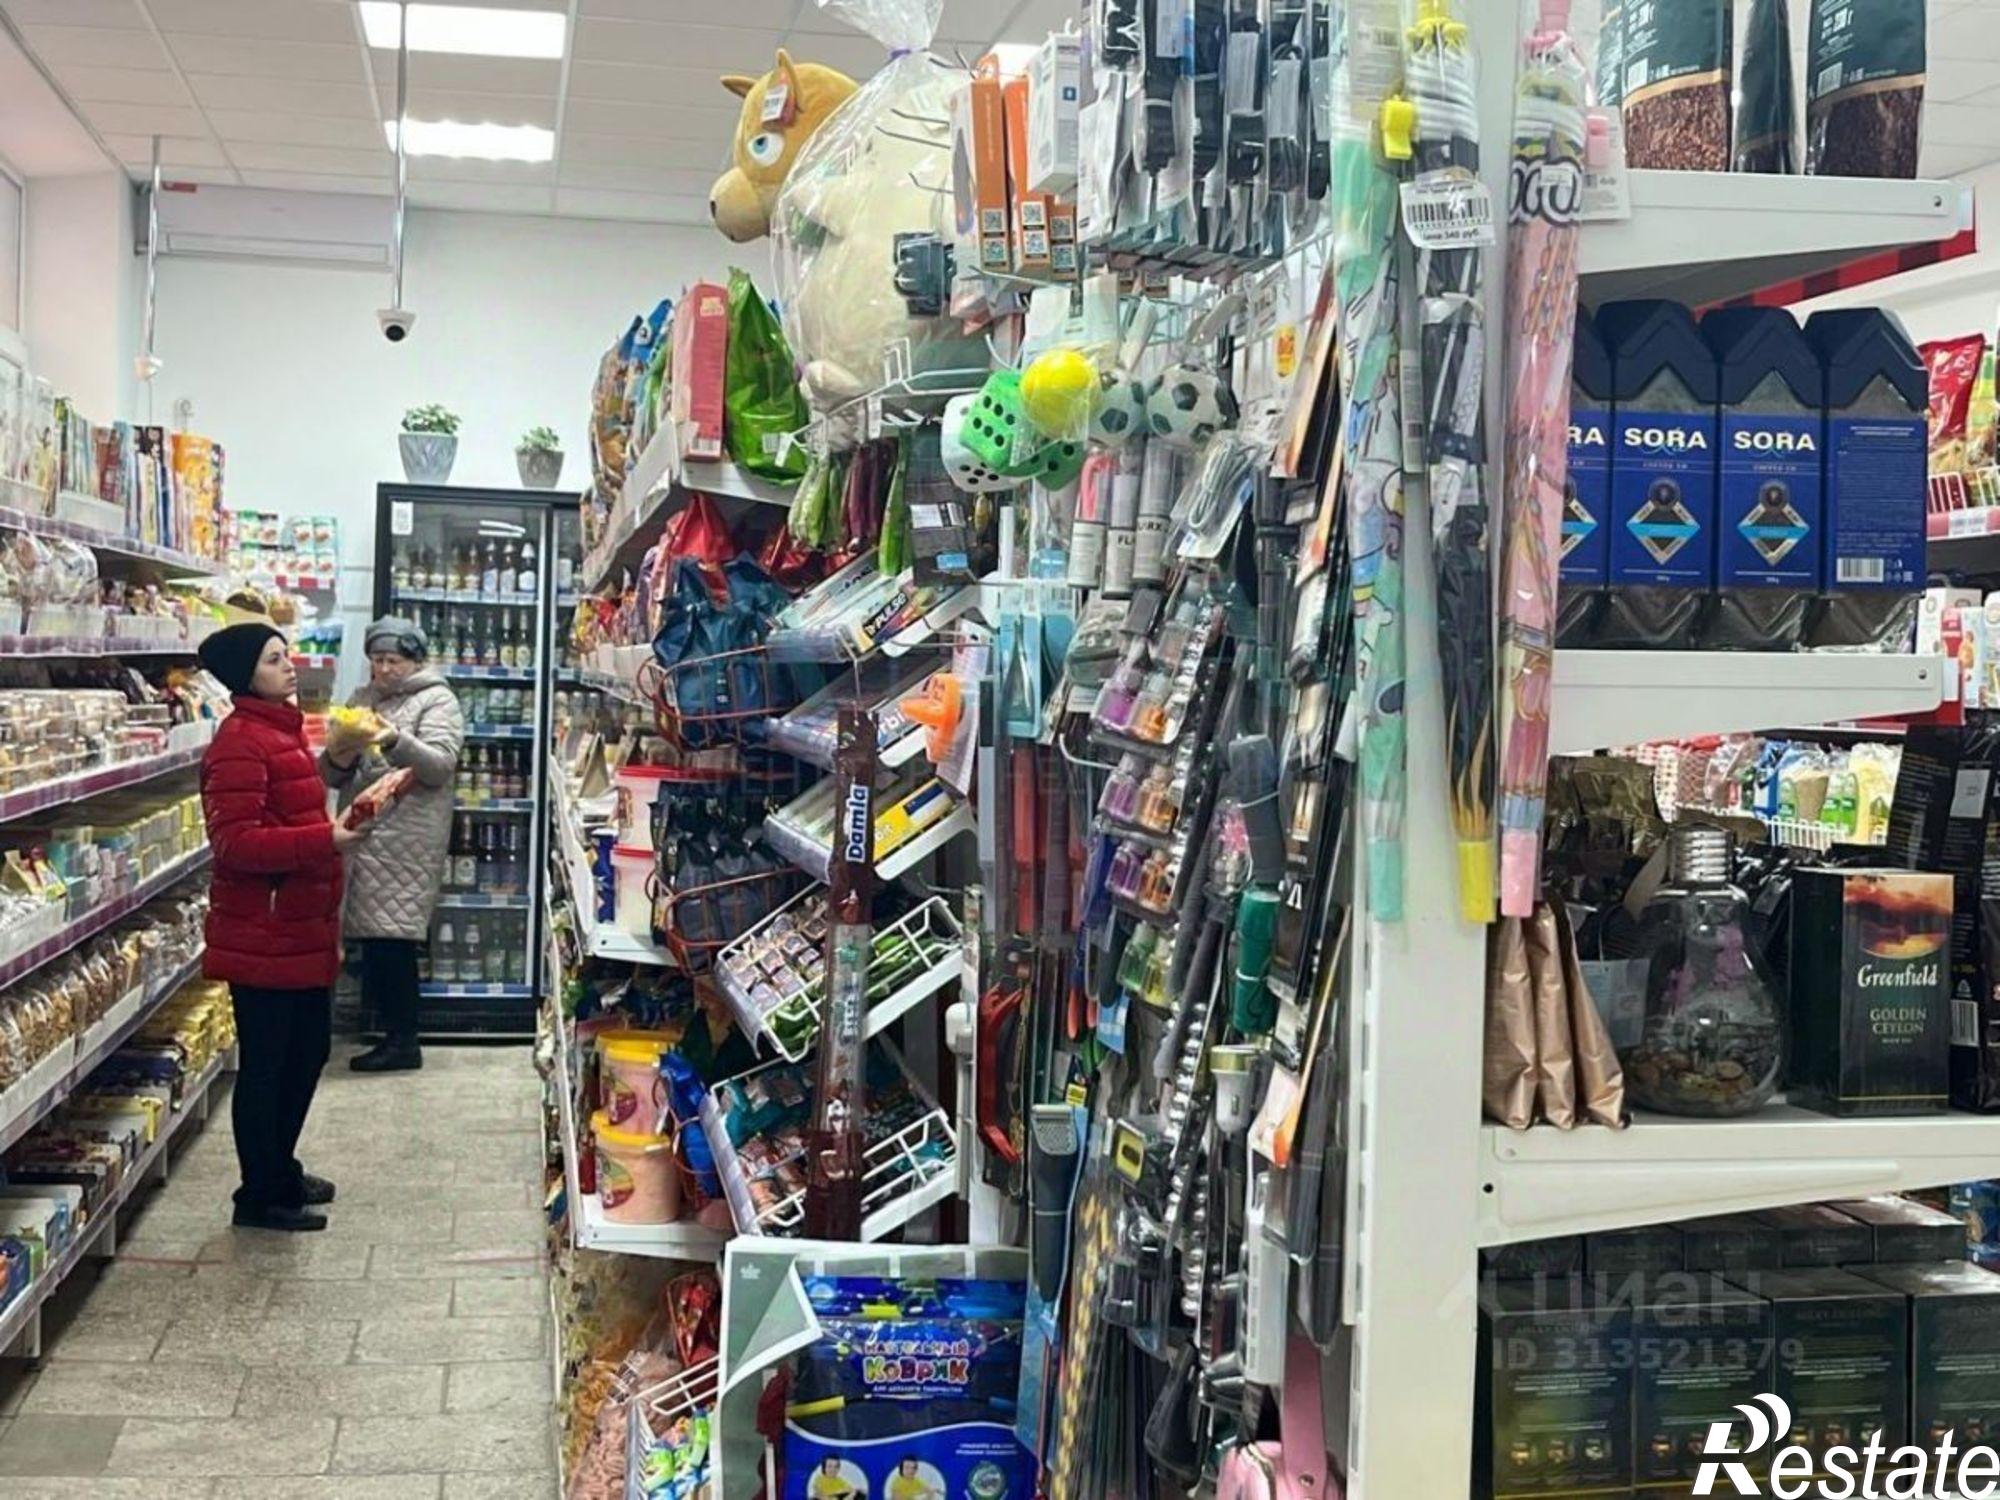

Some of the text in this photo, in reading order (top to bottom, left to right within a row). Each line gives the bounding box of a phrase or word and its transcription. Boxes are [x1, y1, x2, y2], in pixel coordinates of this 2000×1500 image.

[1567, 426, 1605, 446] RA
[1624, 427, 1707, 449] SORA
[1733, 430, 1816, 451] SORA
[847, 786, 867, 862] Damla
[1857, 963, 1938, 988] Greenfield
[1870, 1008, 1927, 1022] GOLDEN
[1872, 1022, 1924, 1035] CEYLON
